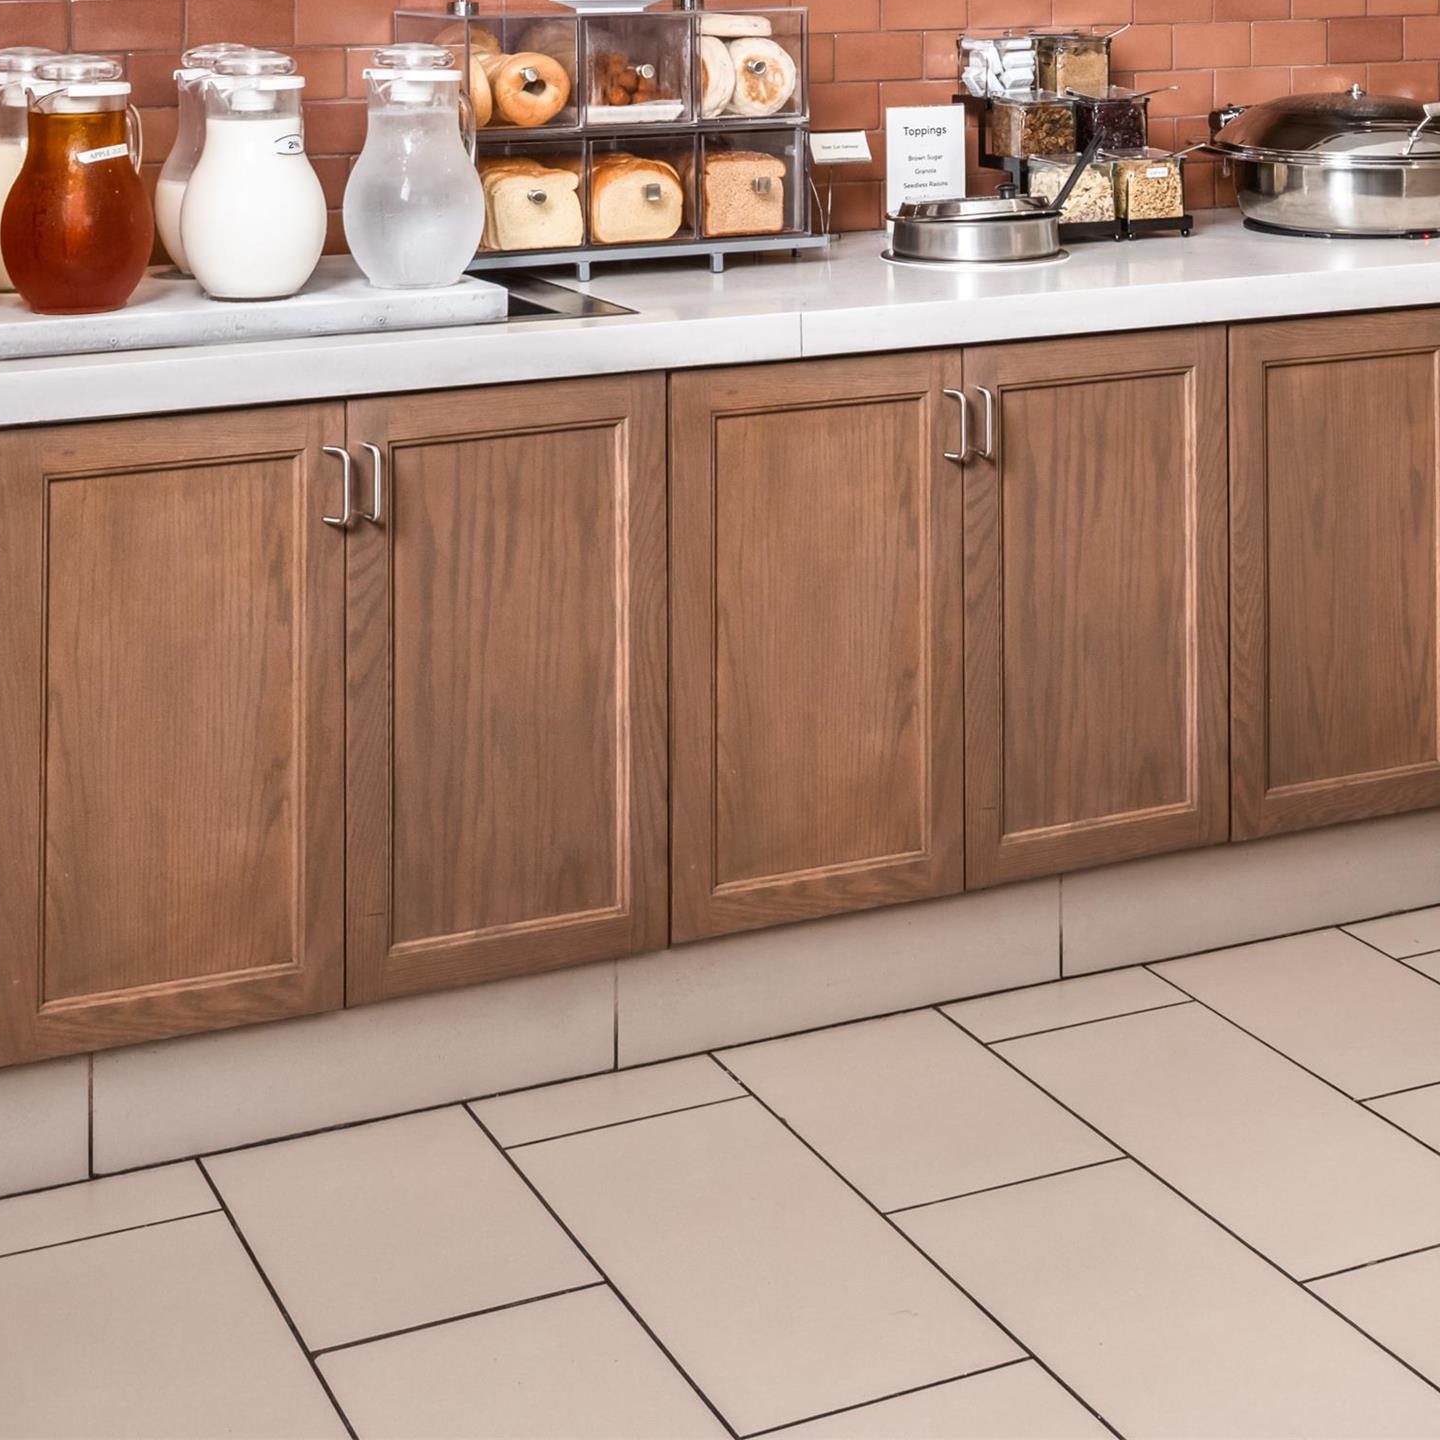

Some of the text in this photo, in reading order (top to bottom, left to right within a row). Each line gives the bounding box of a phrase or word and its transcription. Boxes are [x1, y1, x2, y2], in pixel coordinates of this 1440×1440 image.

[903, 126, 947, 138] Toppings
[89, 149, 111, 159] APPLE
[926, 154, 943, 162] Sugar
[903, 180, 949, 190] Seedless Raisins
